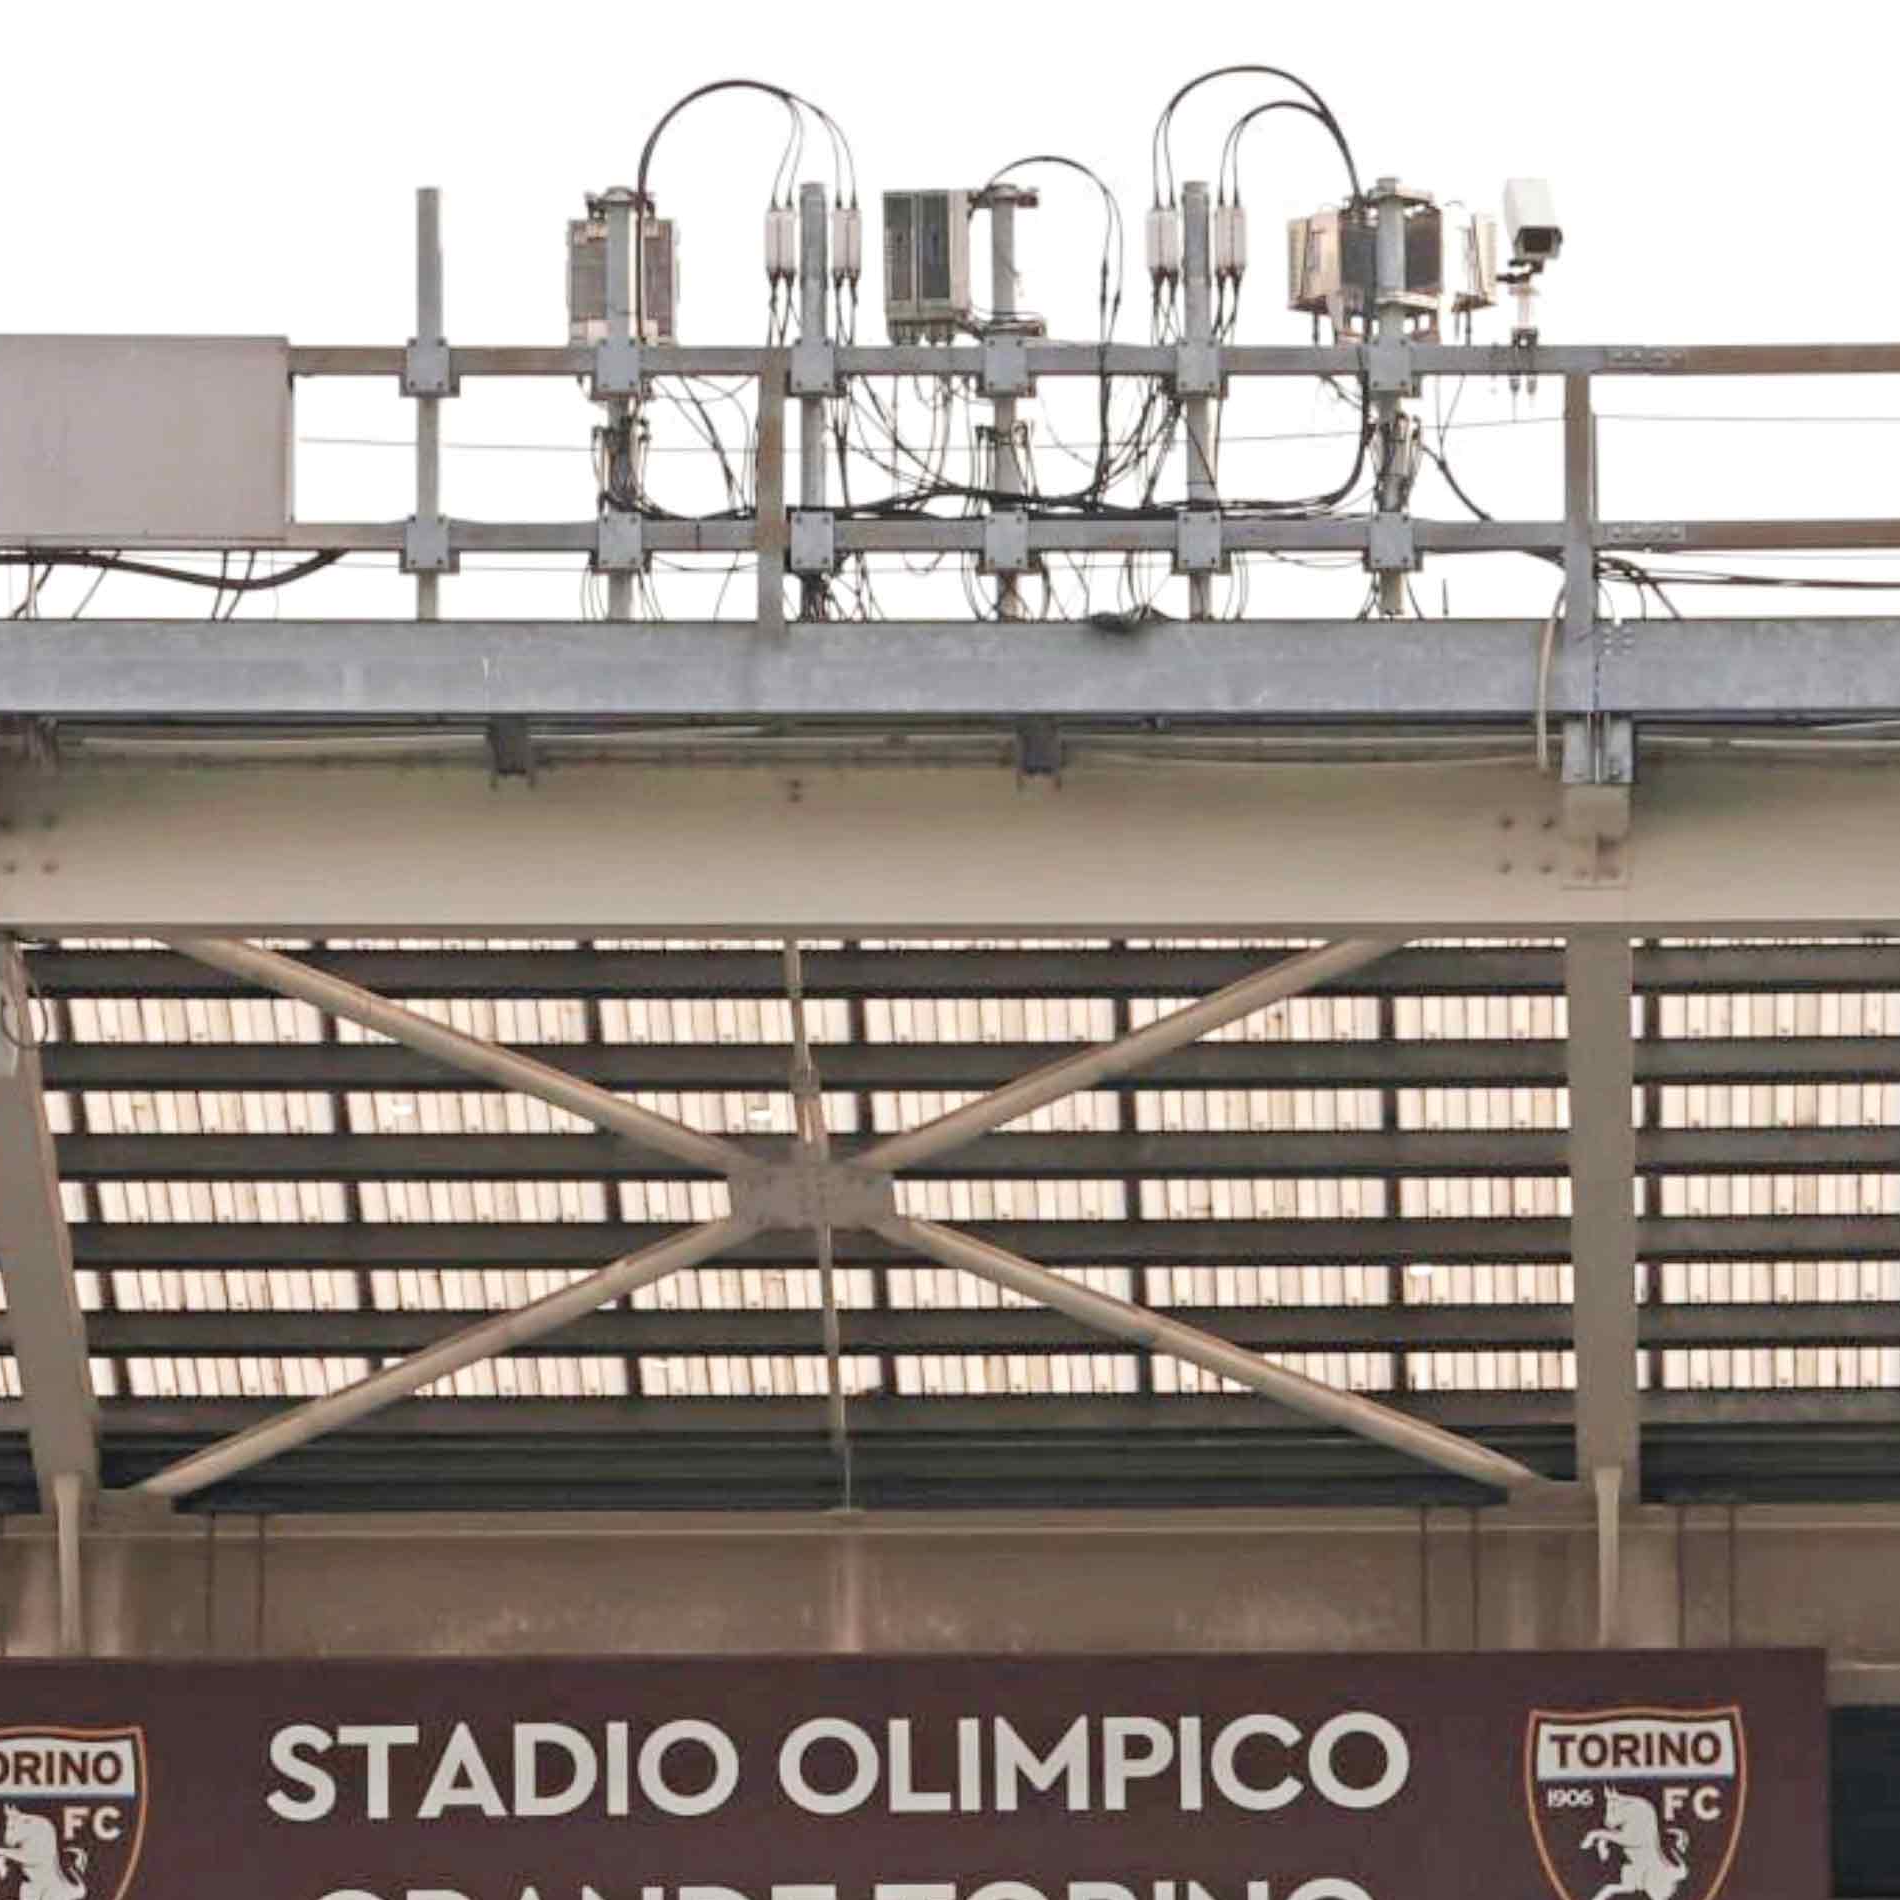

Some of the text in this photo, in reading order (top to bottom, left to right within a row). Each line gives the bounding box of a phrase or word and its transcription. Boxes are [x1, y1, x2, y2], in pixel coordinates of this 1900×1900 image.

[266, 1710, 1410, 1822] STADIO OLIMPICO
[1549, 1731, 1722, 1769] TORINO
[1546, 1788, 1594, 1808] 1906
[1663, 1785, 1721, 1822] FC
[63, 1805, 122, 1841] FC
